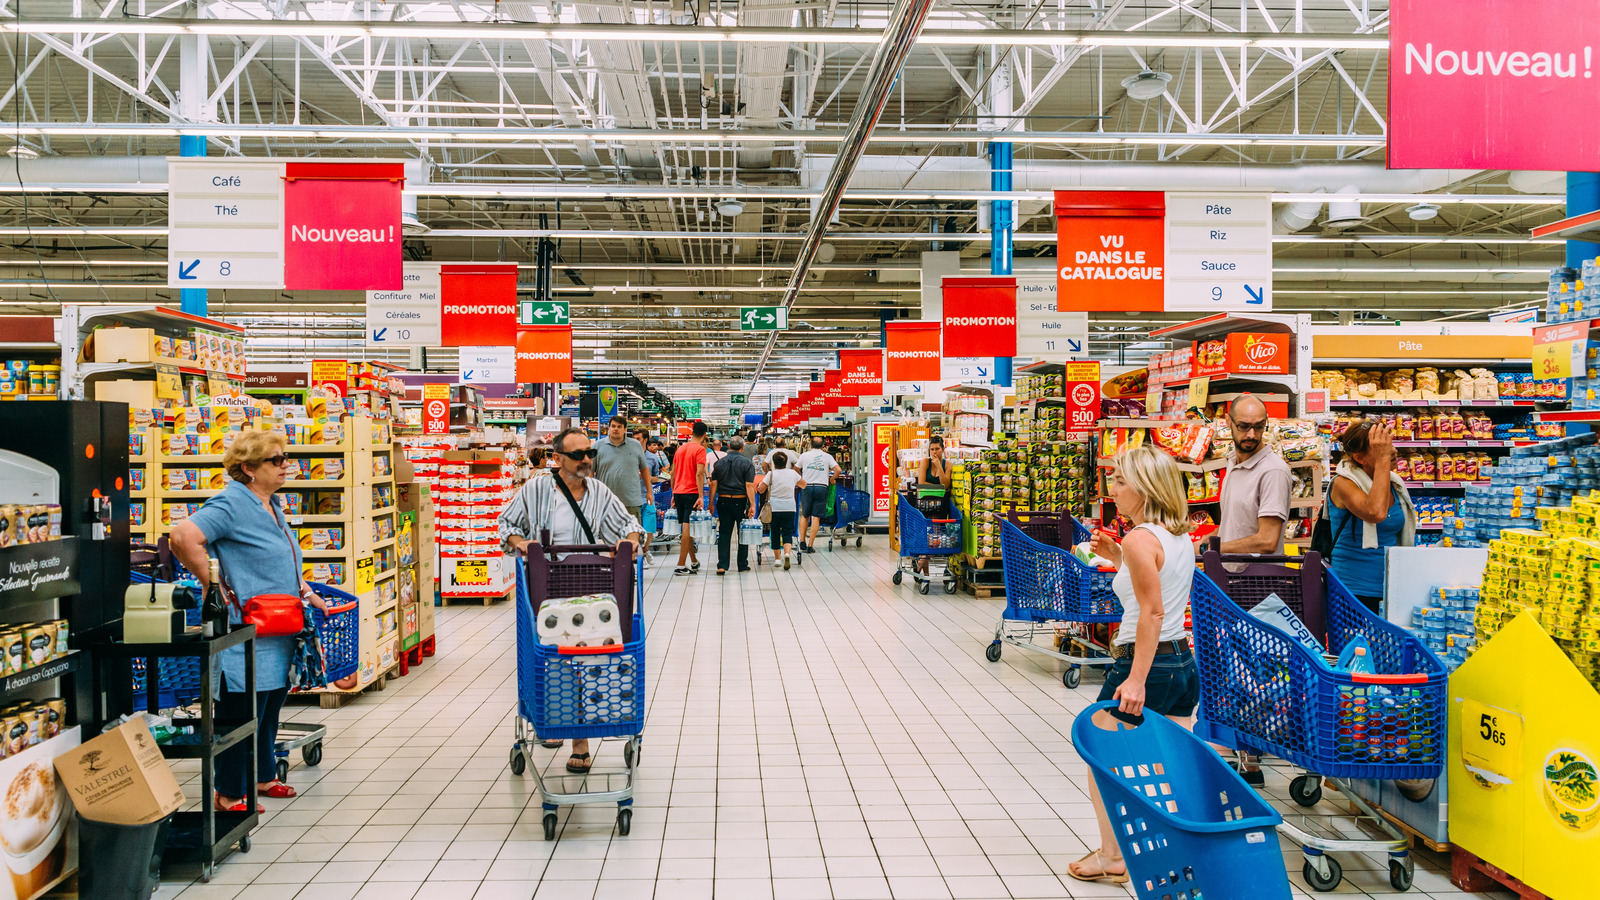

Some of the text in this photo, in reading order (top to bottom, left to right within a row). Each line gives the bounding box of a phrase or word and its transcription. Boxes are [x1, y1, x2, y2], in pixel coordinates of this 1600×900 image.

[212, 175, 241, 188] Café
[214, 205, 238, 217] Thé
[1205, 204, 1232, 215] Pâte
[1210, 230, 1227, 240] Riz
[1099, 235, 1124, 248] VU
[1075, 251, 1146, 264] DANS LE
[219, 261, 231, 276] 8
[1201, 260, 1237, 271] Sauce
[403, 273, 420, 282] otte
[1060, 266, 1163, 280] CATALOGUE
[1023, 285, 1043, 293] Huile
[1211, 286, 1223, 301] 9
[373, 292, 436, 301] Confiture Miel
[443, 304, 516, 315] PROMOTION
[1030, 303, 1042, 311] Sel
[385, 311, 421, 319] Céréales
[945, 316, 1015, 327] PROMOTION
[1041, 321, 1062, 329] Huile
[396, 329, 411, 340] 10
[1045, 340, 1056, 350] 11
[1398, 340, 1423, 351] Pâte
[516, 352, 571, 361] PROMOTION
[888, 350, 940, 358] PROMOTION
[1250, 344, 1276, 360] Vico
[481, 369, 490, 378] 12
[960, 367, 970, 376] 13
[259, 375, 278, 384] grillé
[1072, 411, 1094, 422] 500
[428, 420, 445, 430] 500
[9, 556, 61, 574] Nouvelle recette
[0, 566, 70, 592] Sélection Gourmande
[1276, 606, 1326, 655] picard
[75, 765, 133, 796] VALESTREL
[107, 776, 133, 792] PROVENCE
